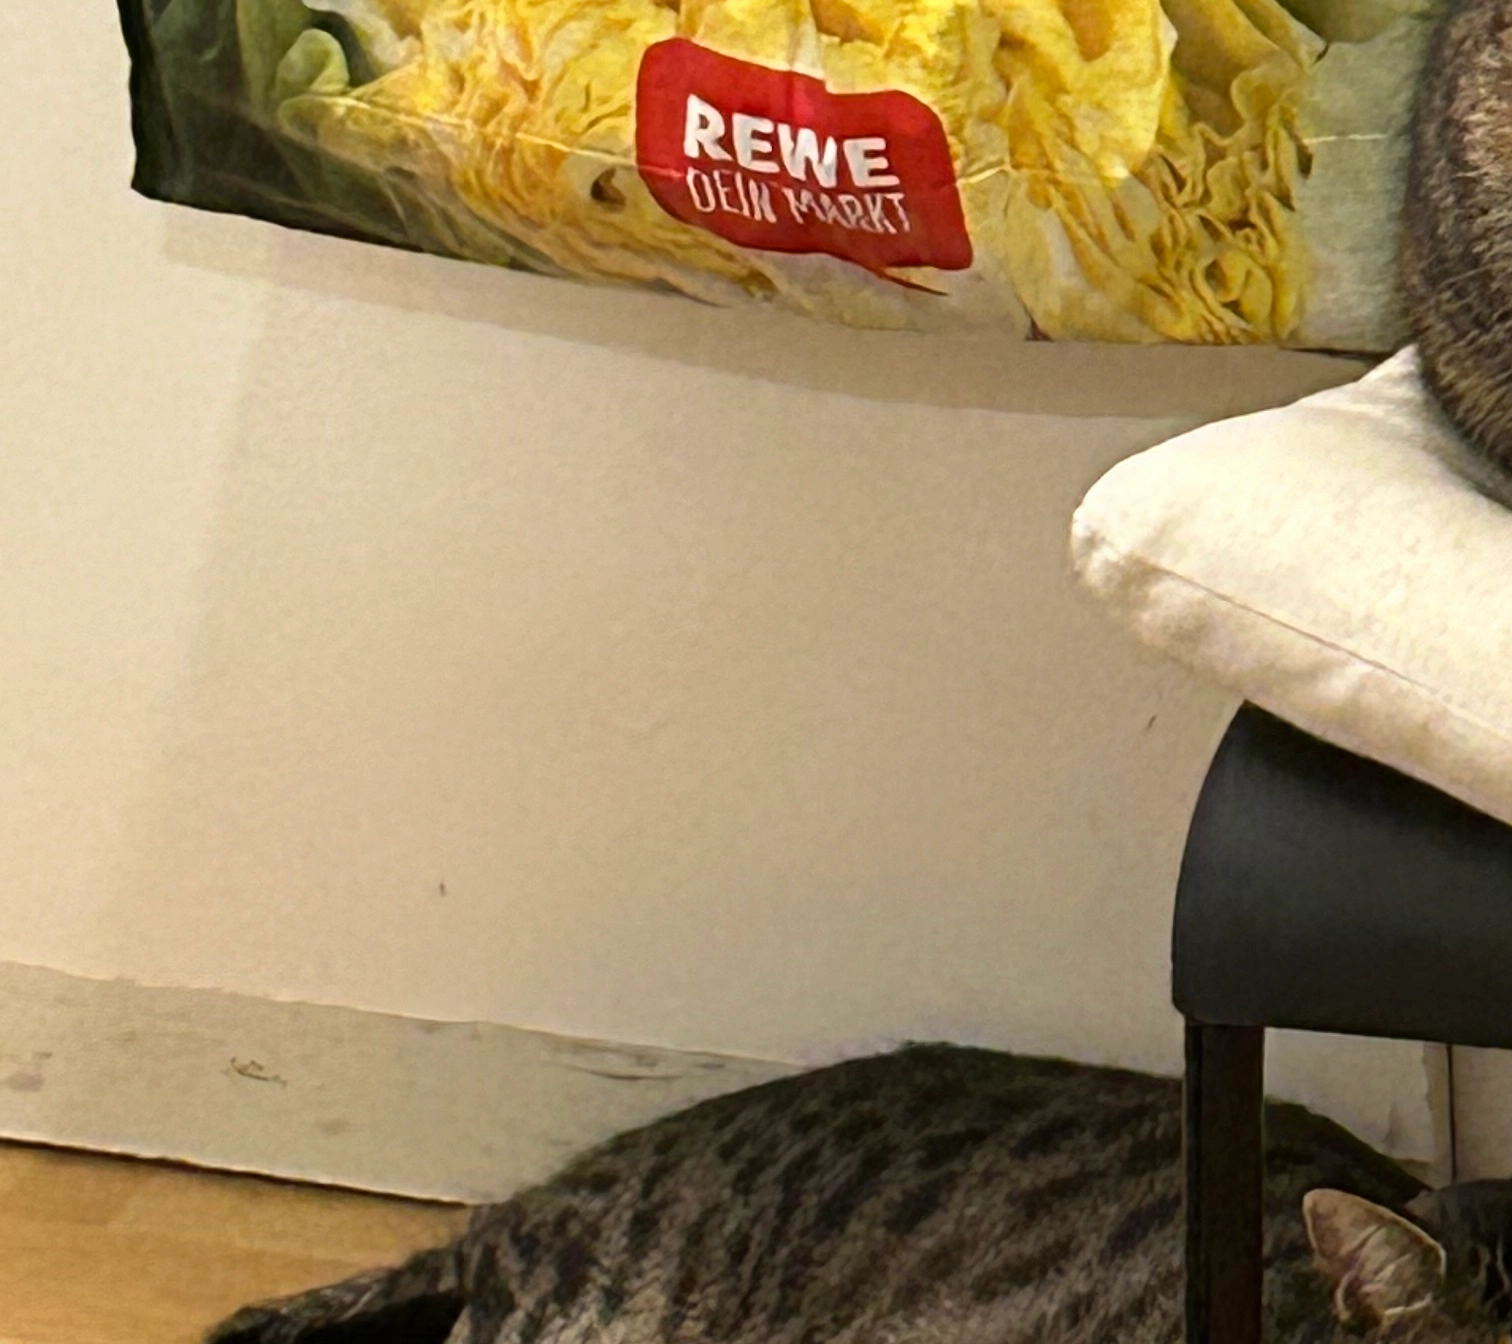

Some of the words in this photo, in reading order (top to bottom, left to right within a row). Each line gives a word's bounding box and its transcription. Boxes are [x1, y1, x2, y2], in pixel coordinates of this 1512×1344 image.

[683, 93, 901, 189] REWE
[685, 166, 777, 224] DEIN
[782, 187, 911, 235] MARKT
